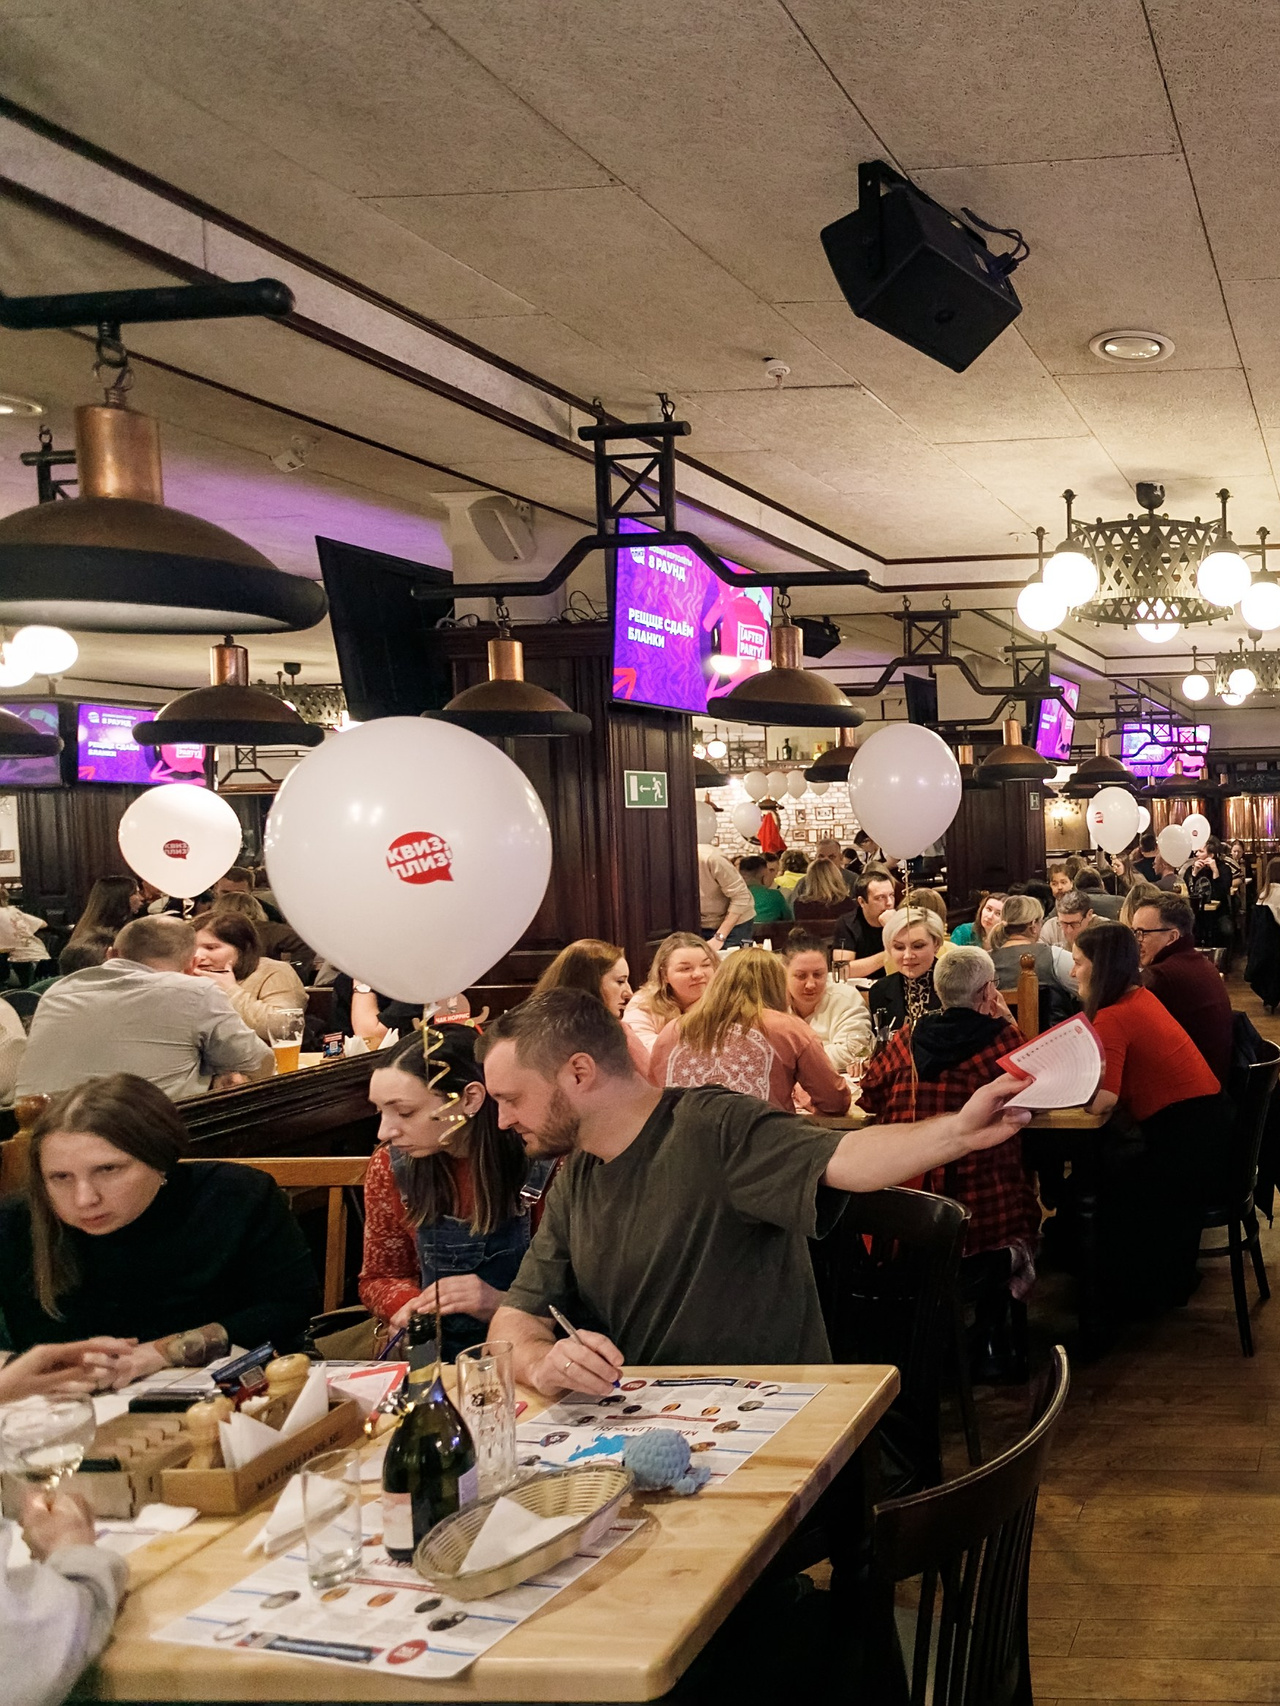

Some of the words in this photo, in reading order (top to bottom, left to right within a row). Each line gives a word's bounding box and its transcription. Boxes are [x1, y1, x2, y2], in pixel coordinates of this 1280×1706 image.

[648, 555, 655, 568] 8
[656, 557, 686, 582] РАУНД
[628, 626, 665, 648] БЛАНКИ
[664, 618, 694, 638] СДАЁМ
